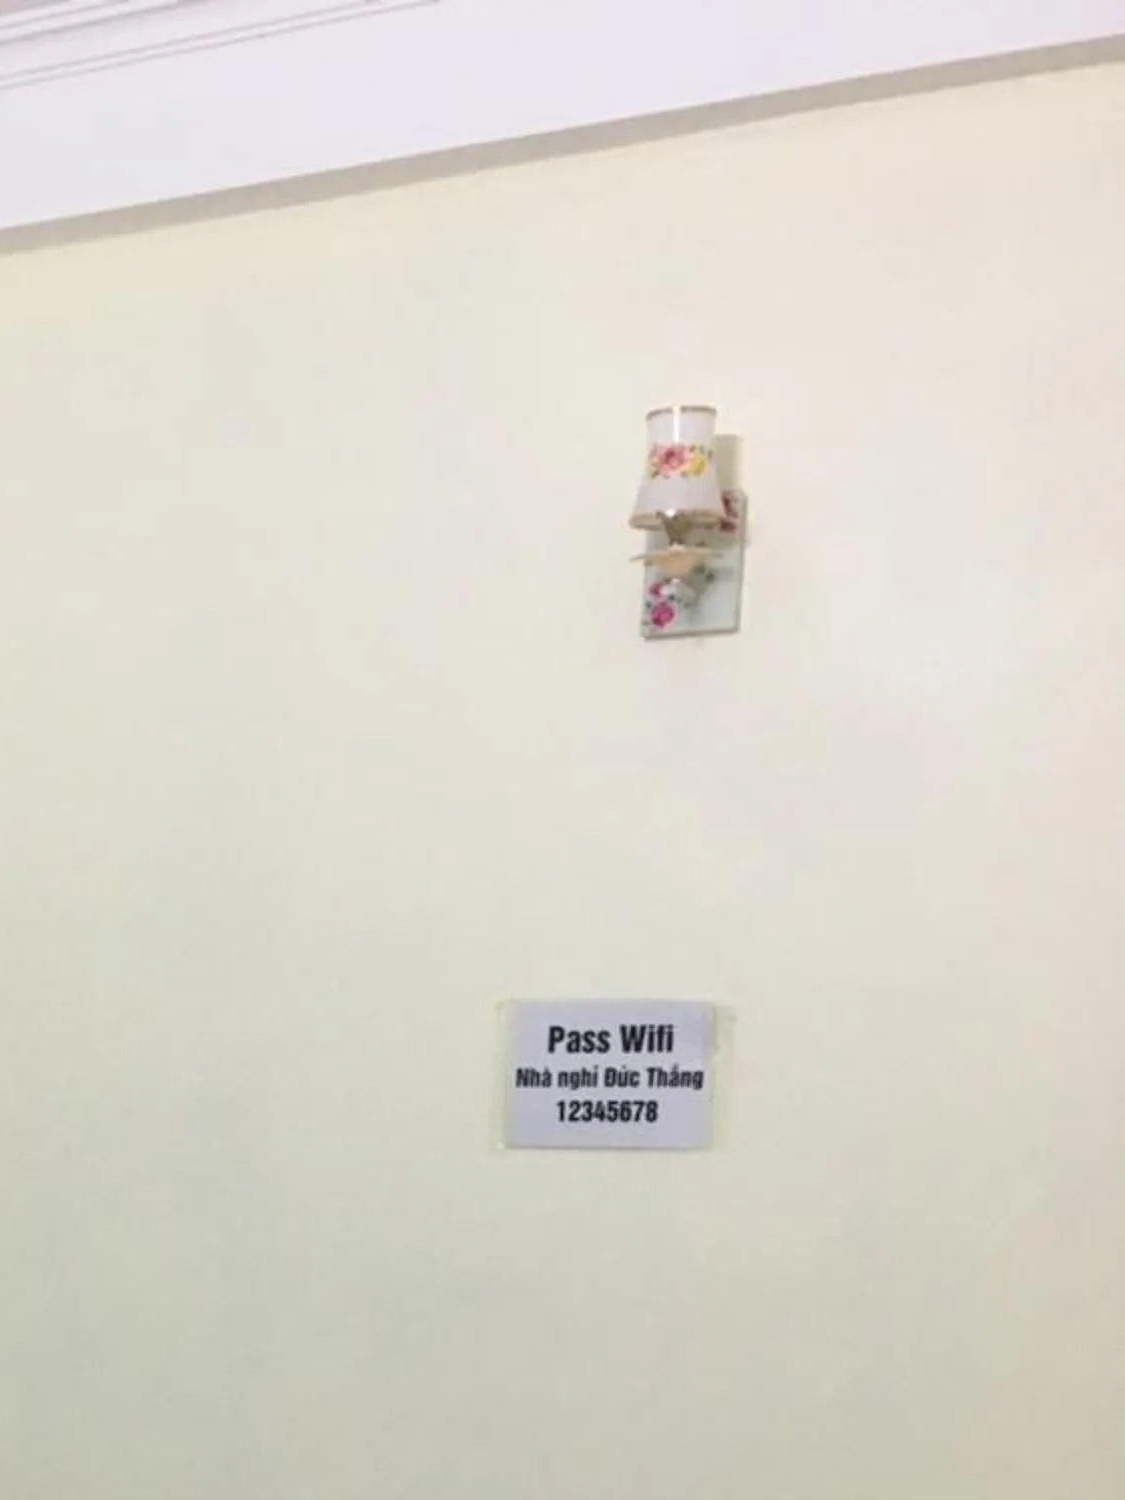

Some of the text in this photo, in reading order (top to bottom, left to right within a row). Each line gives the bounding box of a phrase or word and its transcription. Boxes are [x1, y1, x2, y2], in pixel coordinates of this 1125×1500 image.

[548, 1023, 674, 1053] Pass Wifi
[557, 1100, 659, 1123] 12345678
